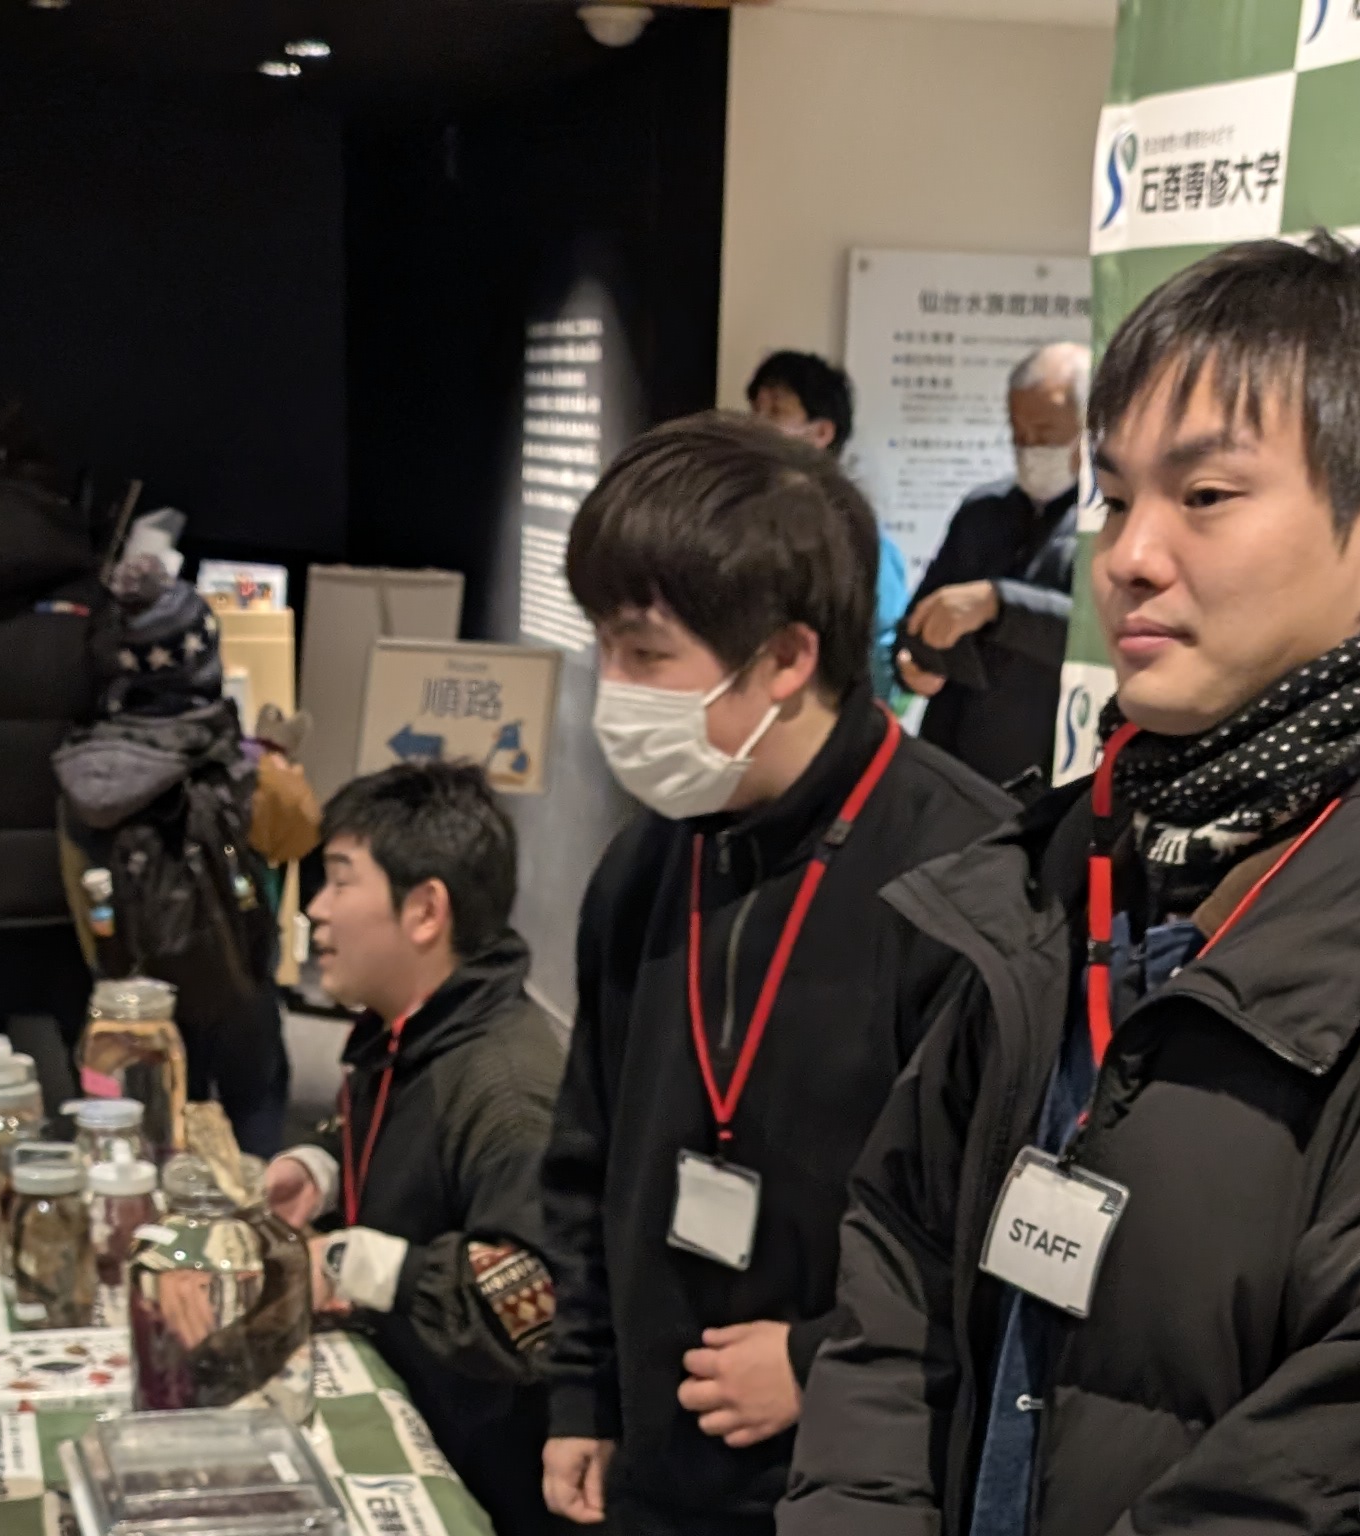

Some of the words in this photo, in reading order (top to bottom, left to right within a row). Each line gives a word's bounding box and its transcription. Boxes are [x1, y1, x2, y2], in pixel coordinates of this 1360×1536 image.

[1137, 150, 1280, 214] 石巻専修大学
[1009, 1217, 1081, 1263] STAFF
